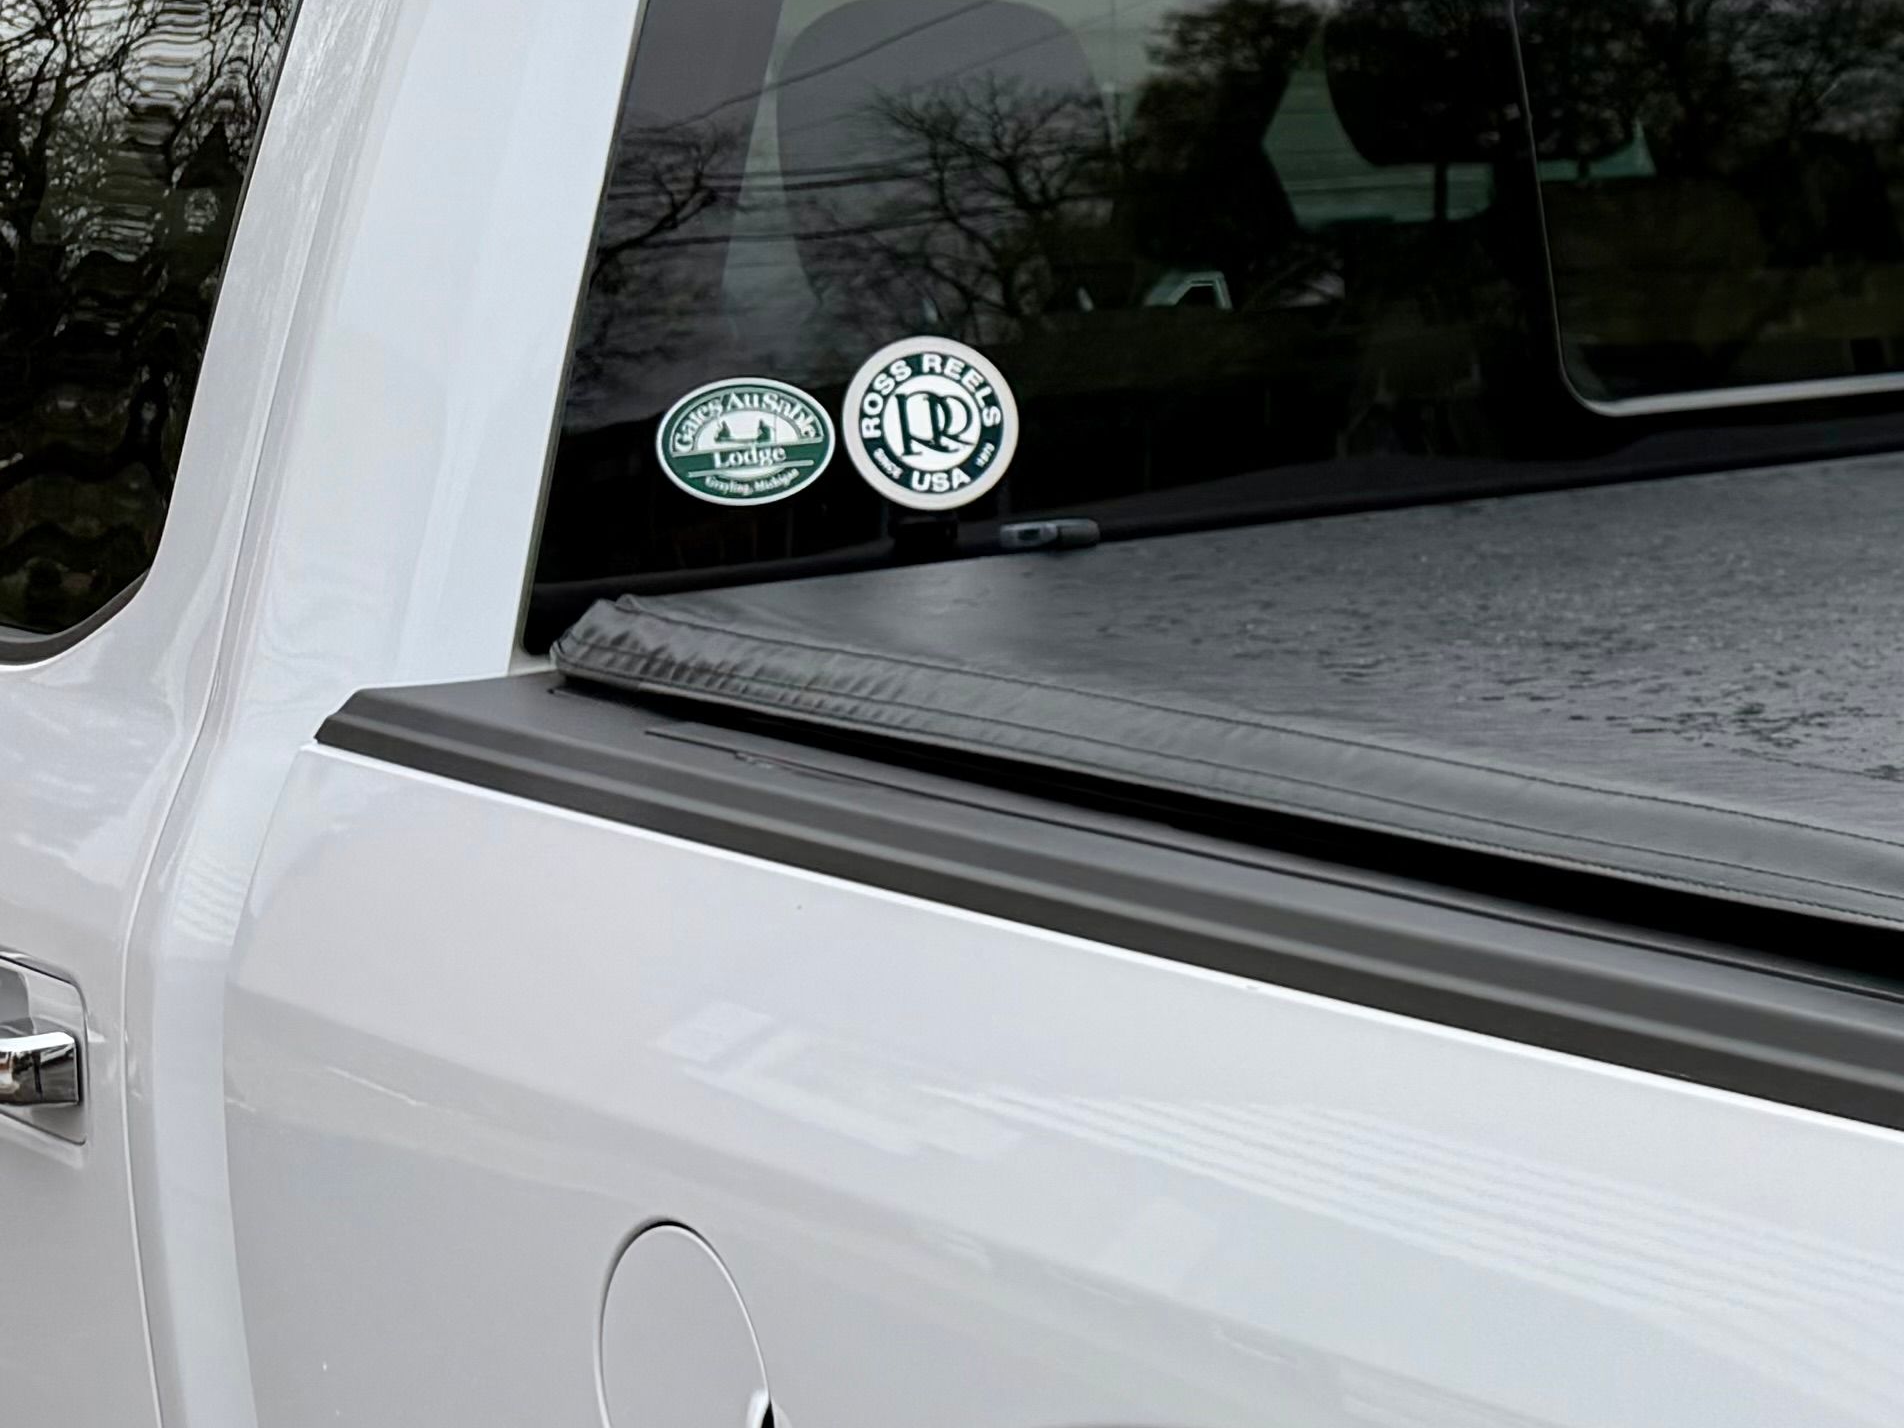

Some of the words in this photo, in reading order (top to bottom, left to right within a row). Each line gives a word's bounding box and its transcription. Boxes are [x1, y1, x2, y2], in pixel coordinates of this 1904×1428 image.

[861, 359, 912, 439] ROSS
[922, 353, 1002, 427] REELS
[674, 397, 724, 452] Gates
[714, 442, 787, 468] Lodge
[754, 468, 800, 492] Michigan
[911, 466, 971, 492] USA
